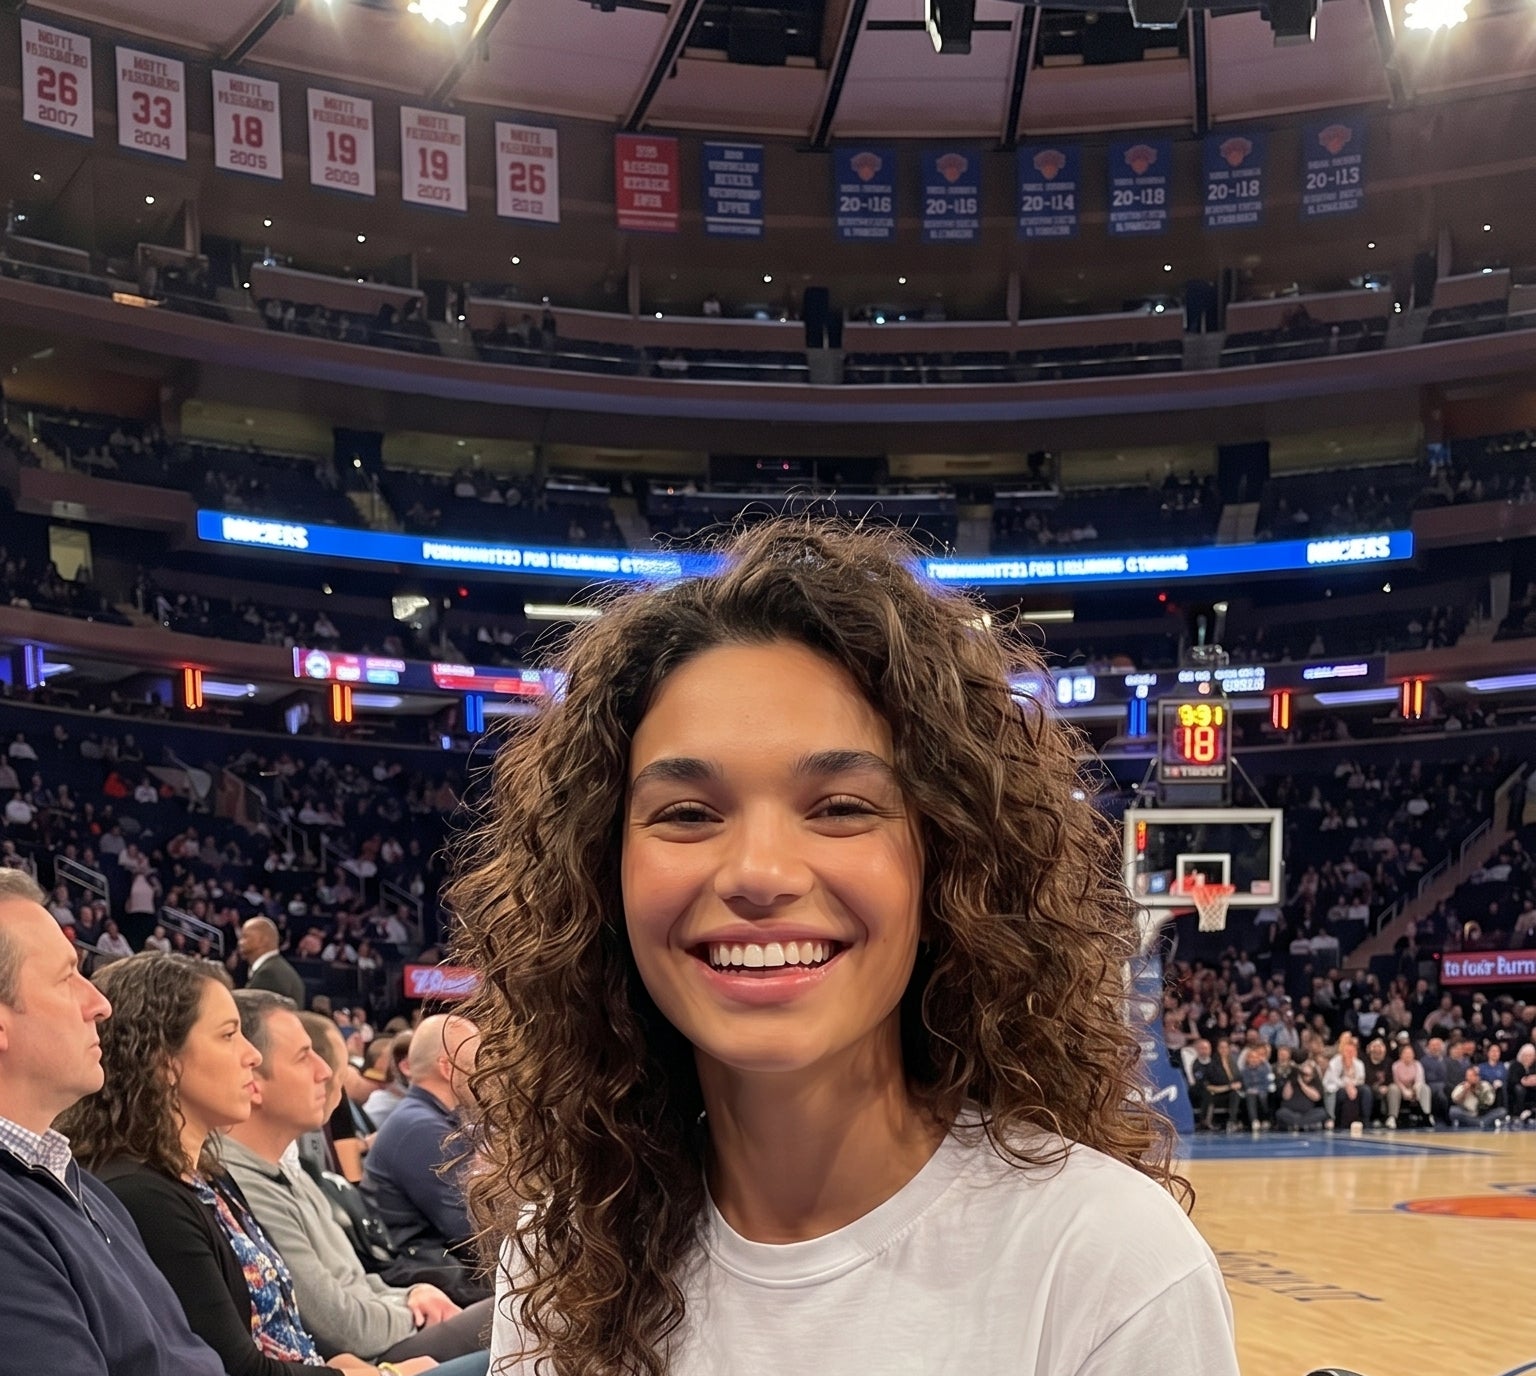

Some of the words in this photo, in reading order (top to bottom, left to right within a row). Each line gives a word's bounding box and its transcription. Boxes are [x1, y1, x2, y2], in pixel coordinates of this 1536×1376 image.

[36, 65, 79, 107] 26
[37, 104, 78, 127] 2007
[131, 90, 172, 130] 33
[231, 113, 263, 148] 18
[326, 130, 358, 165] 19
[418, 146, 449, 182] 19
[508, 161, 547, 195] 26
[1184, 726, 1215, 762] 18
